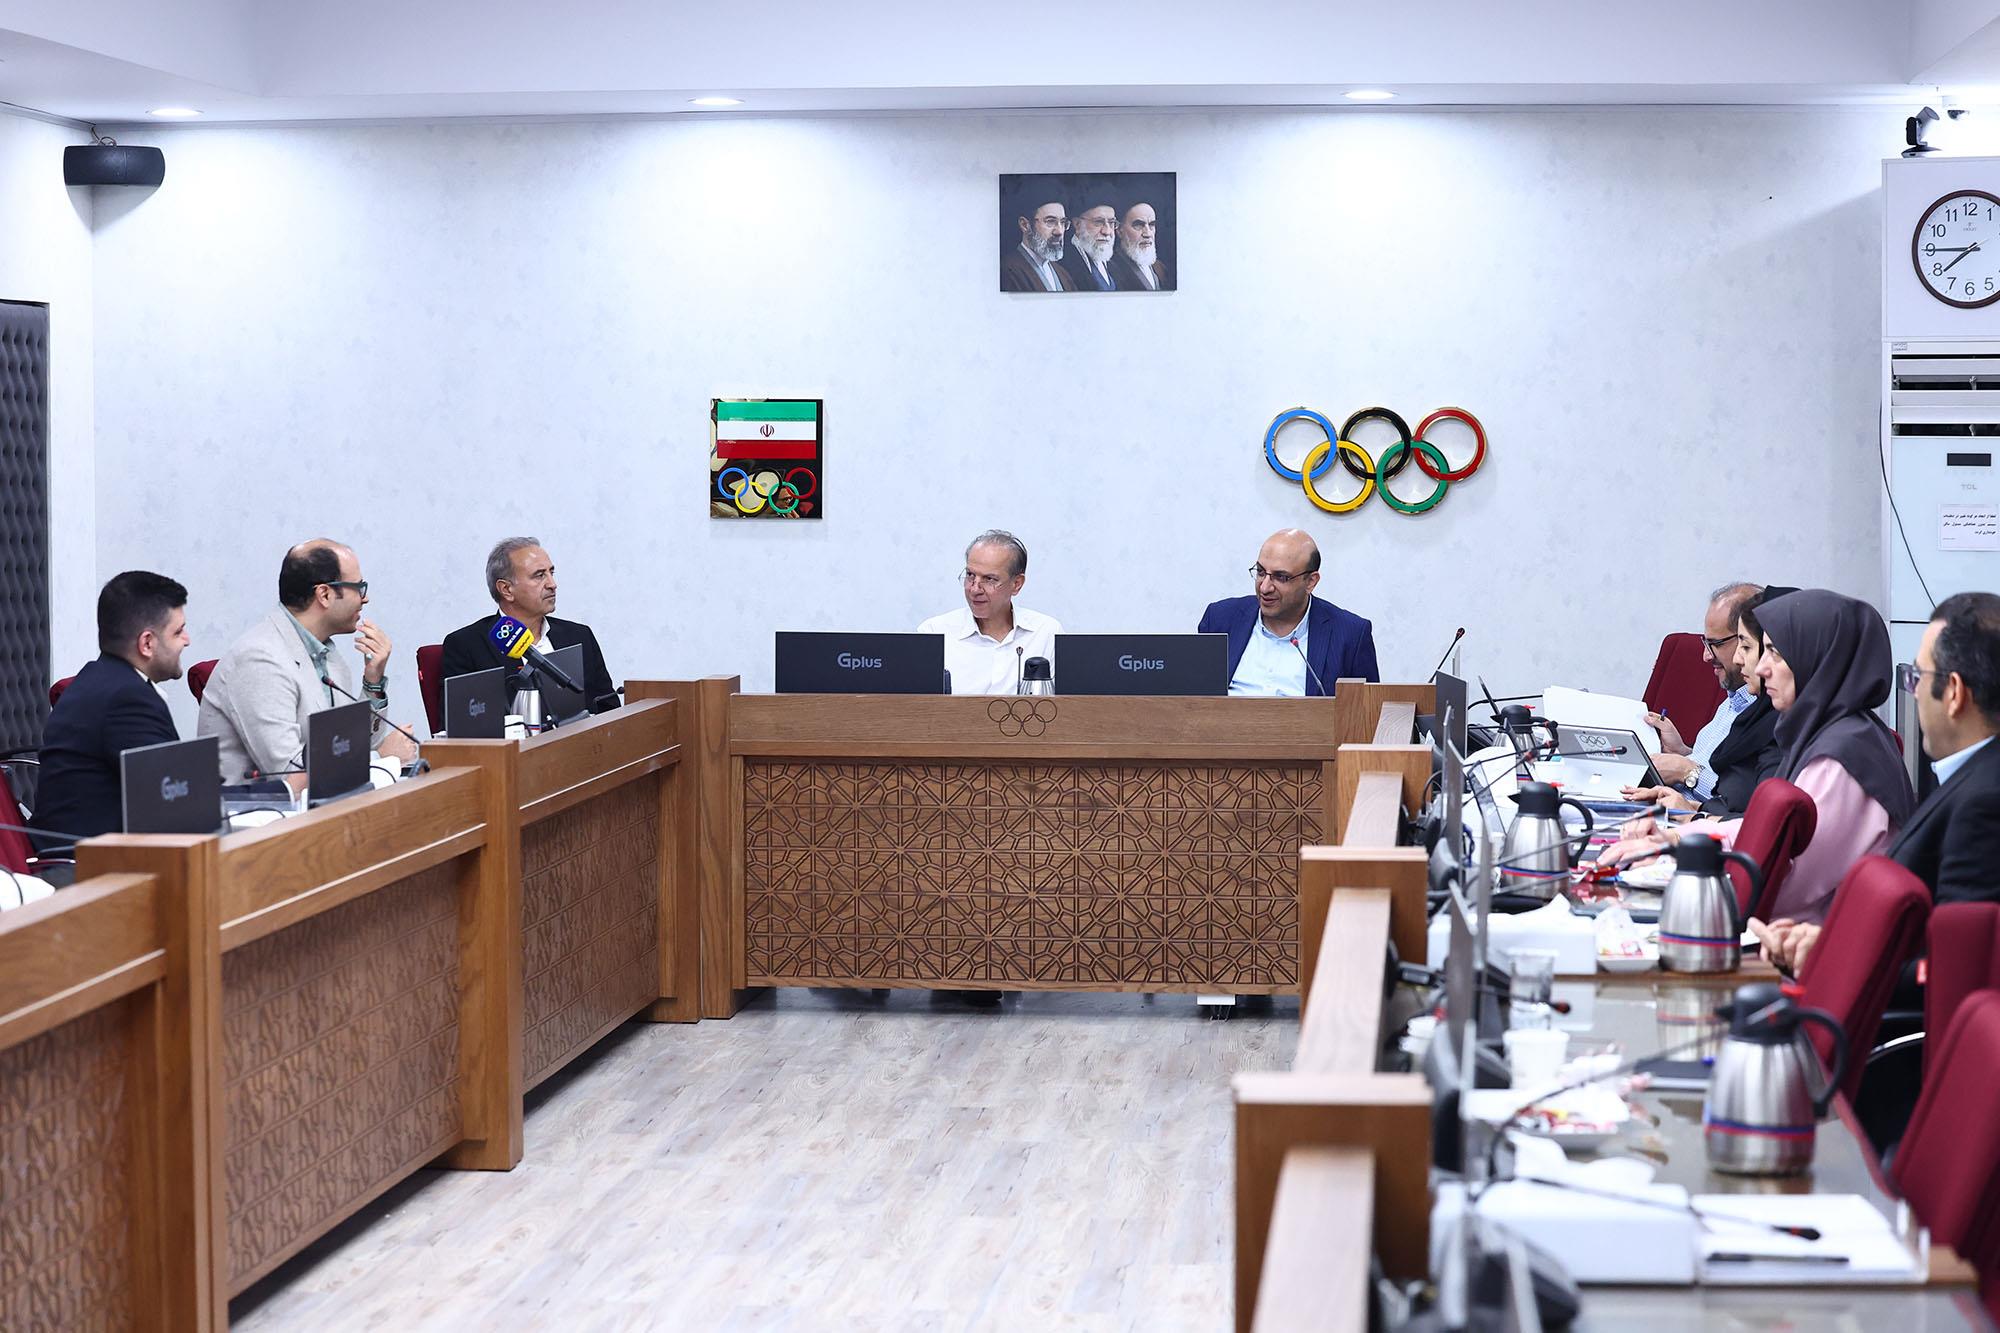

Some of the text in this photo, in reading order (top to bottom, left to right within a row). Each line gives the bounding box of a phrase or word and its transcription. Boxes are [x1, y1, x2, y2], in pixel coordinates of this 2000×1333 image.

[1945, 208, 1958, 222] 11
[1963, 202, 1978, 216] 12
[1987, 207, 1992, 221] 1
[1931, 224, 1946, 238] 10
[1925, 243, 1936, 257] 9
[1933, 263, 1943, 277] 8
[1947, 276, 1957, 290] 7
[1964, 281, 1975, 296] 6
[1984, 277, 1994, 291] 5
[837, 652, 882, 670] Gplus
[1118, 654, 1164, 672] Gplus
